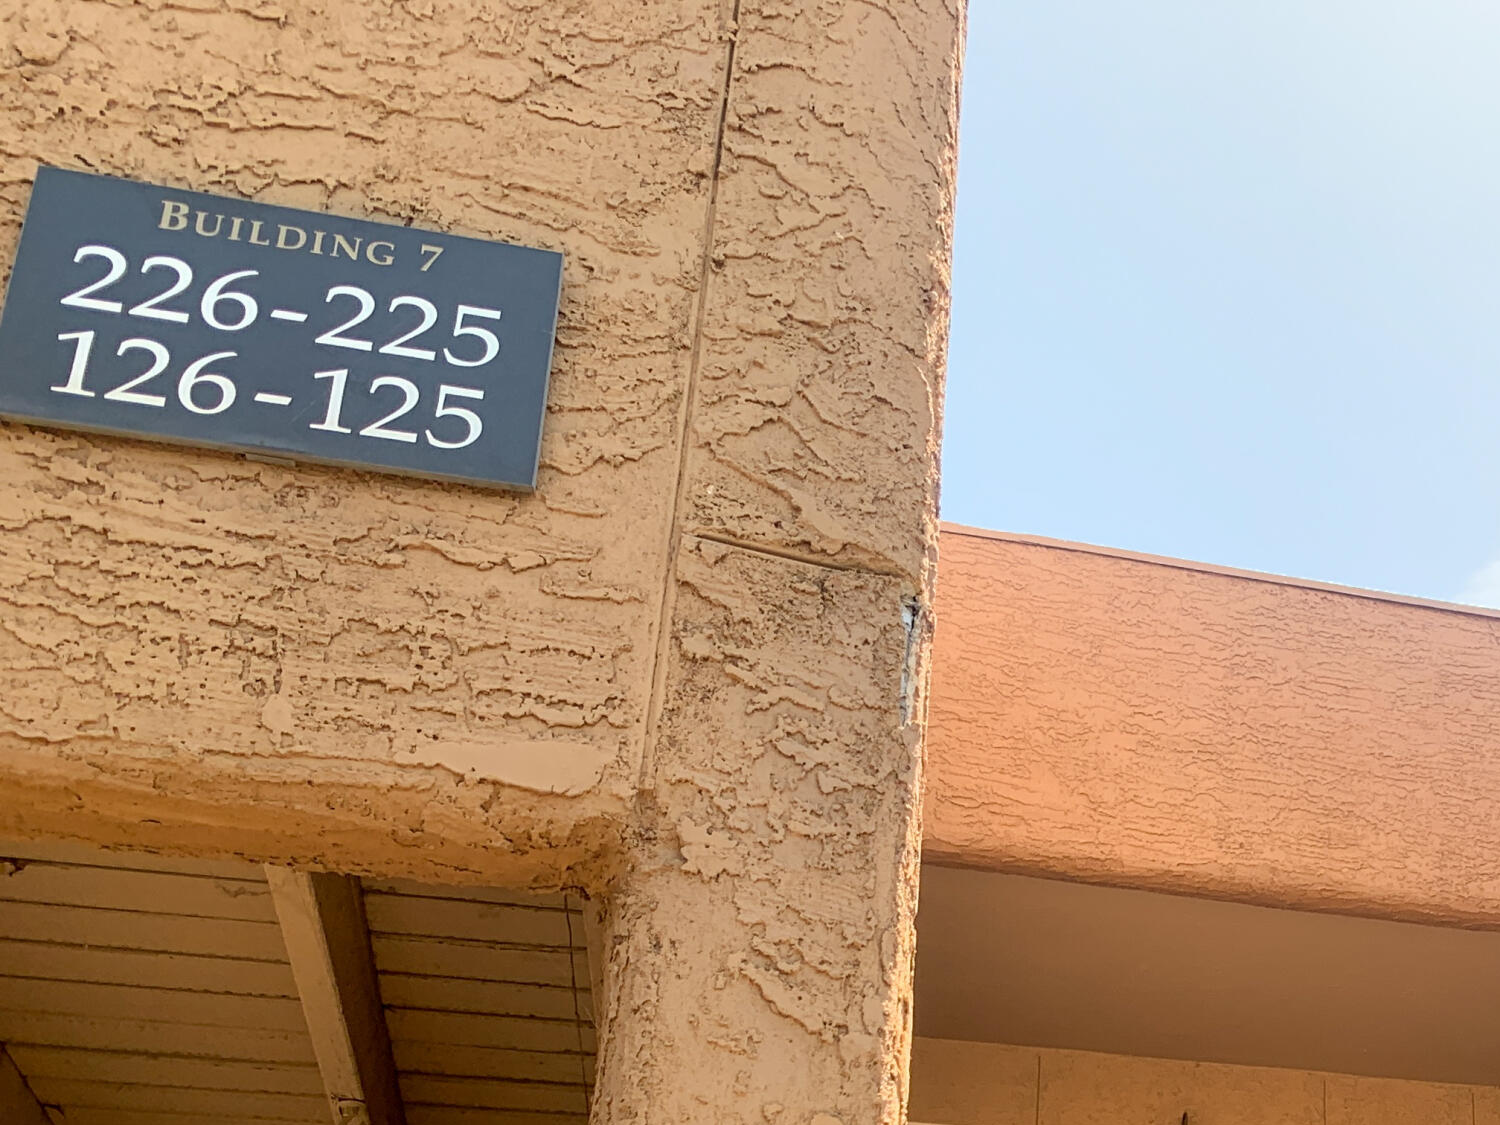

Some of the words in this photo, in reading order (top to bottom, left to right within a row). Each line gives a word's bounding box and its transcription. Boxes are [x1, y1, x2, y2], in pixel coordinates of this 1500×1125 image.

[158, 200, 396, 267] BUILDING
[419, 245, 444, 272] 7
[60, 245, 502, 367] 226-225
[50, 330, 485, 449] 126-125
